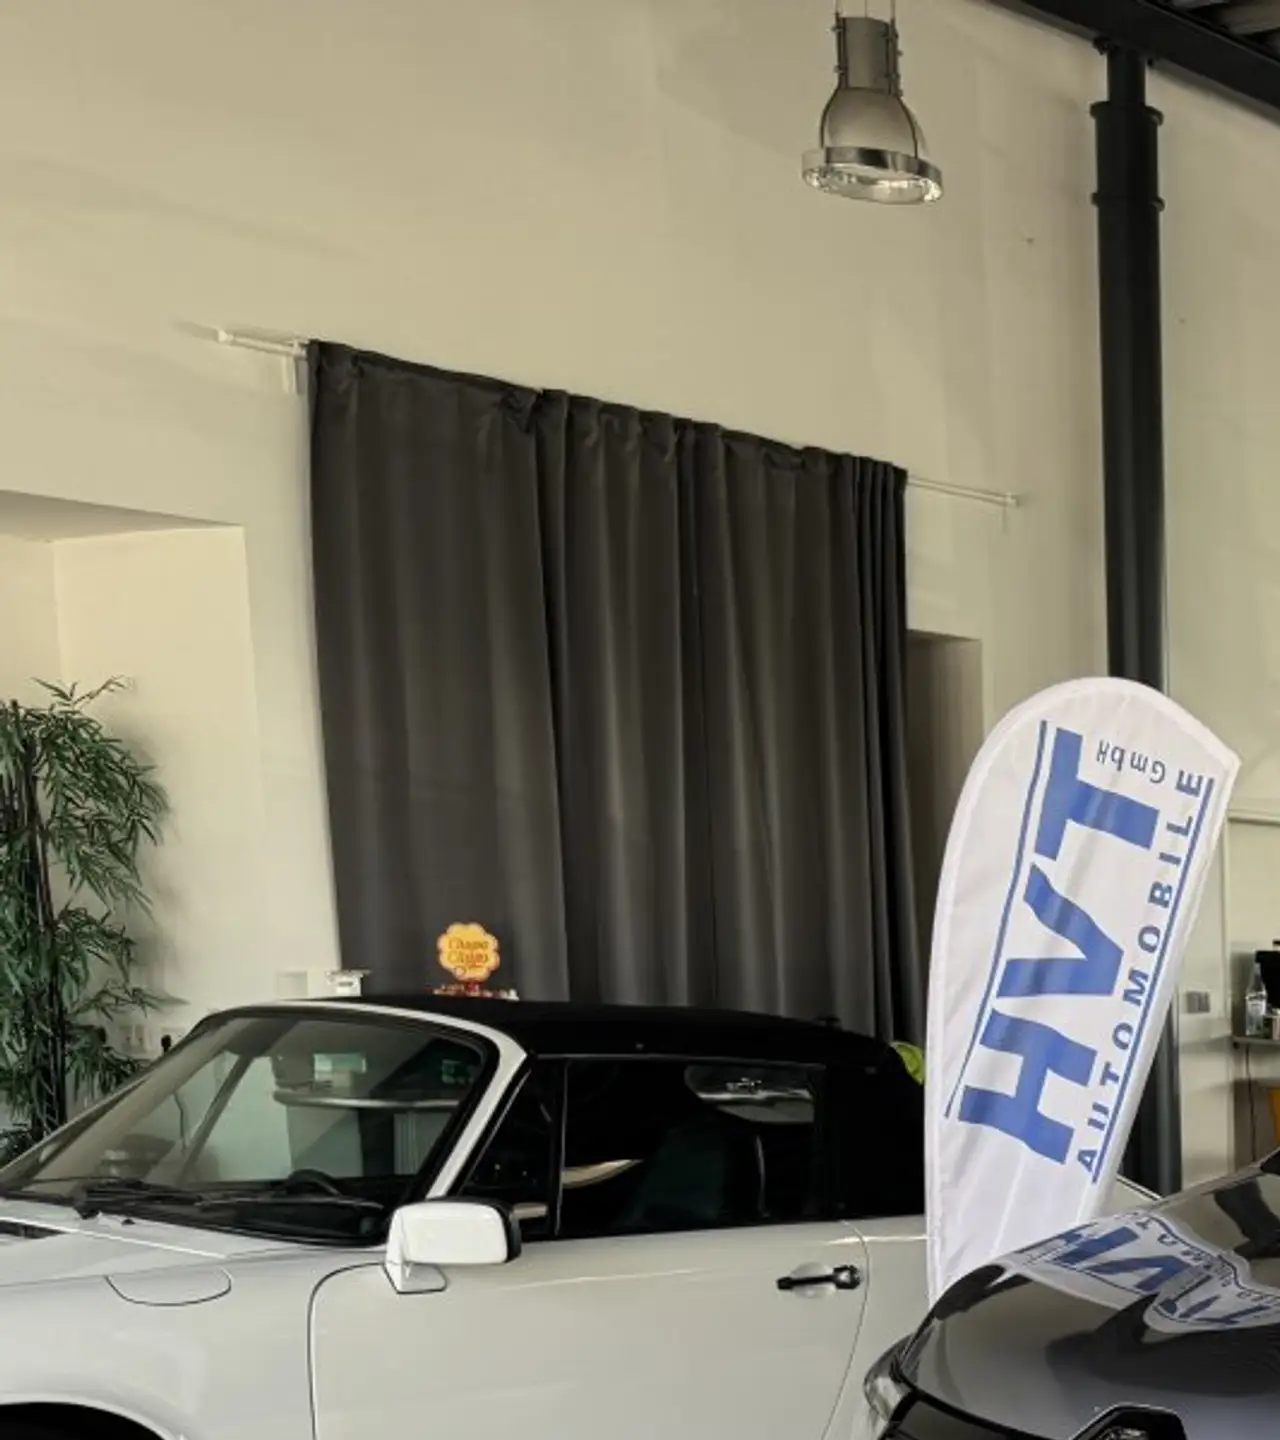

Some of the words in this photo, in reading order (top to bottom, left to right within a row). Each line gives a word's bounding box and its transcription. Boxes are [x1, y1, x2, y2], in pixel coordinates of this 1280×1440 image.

[958, 727, 1159, 1166] HVT
[1096, 739, 1166, 784] GmbH
[1076, 769, 1204, 1174] AUTOMOBILE
